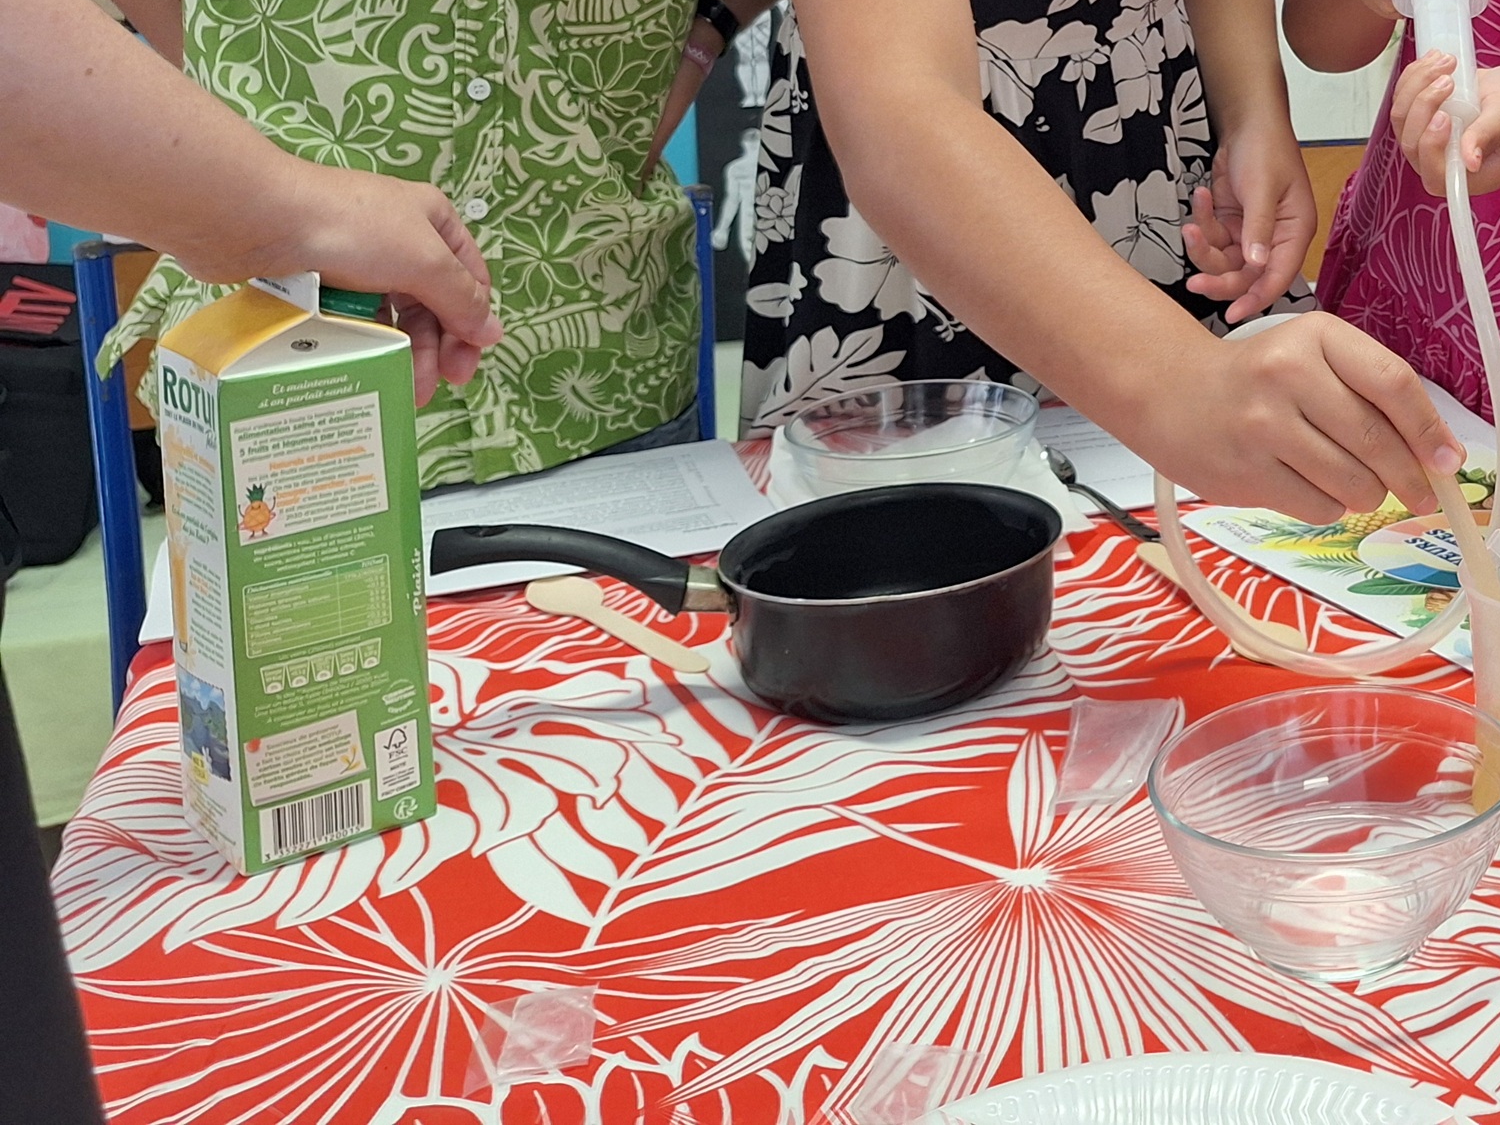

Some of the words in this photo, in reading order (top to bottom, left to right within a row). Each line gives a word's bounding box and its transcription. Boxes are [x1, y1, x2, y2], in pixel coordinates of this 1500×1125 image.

[272, 384, 285, 395] Et
[286, 374, 348, 393] maintenant
[162, 365, 216, 431] ROTUI
[258, 398, 268, 409] si
[271, 398, 284, 407] on
[286, 390, 322, 406] parlait
[238, 425, 290, 442] alimentation
[318, 418, 327, 426] et
[239, 448, 245, 457] 5
[248, 444, 269, 455] fruits
[272, 442, 280, 451] et
[320, 433, 335, 442] par
[338, 429, 354, 439] jour
[413, 548, 422, 616] Plaisir
[388, 746, 408, 759] FSC
[324, 826, 360, 843] 120015
